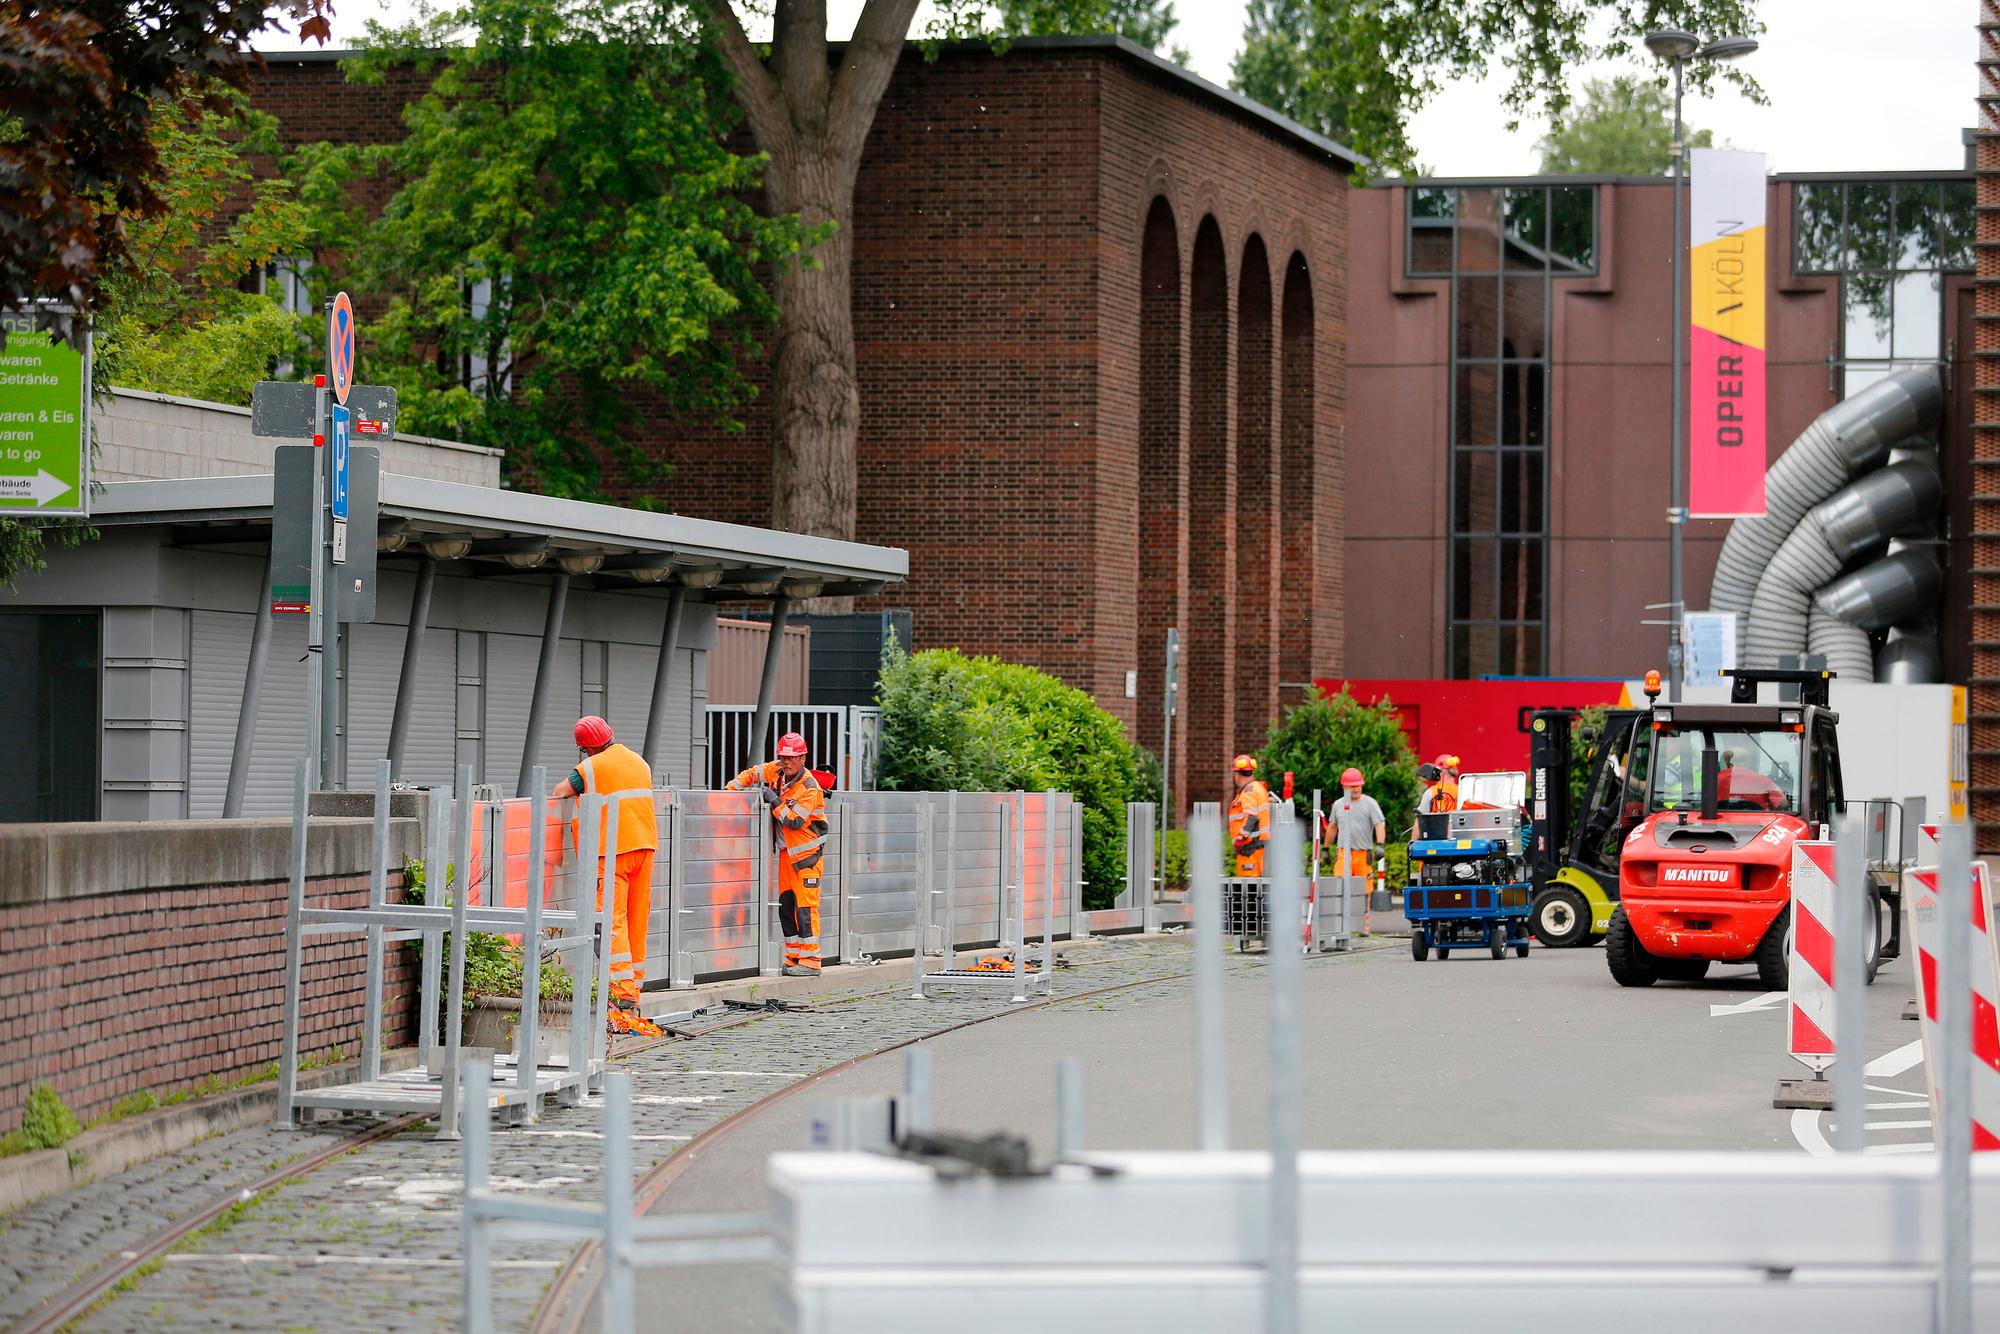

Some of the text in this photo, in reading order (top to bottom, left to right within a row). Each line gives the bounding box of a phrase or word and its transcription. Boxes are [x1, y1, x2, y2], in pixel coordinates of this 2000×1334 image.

[1711, 220, 1744, 295] KÖLN
[6, 334, 46, 347] inigung
[1716, 355, 1744, 448] OPER
[38, 409, 48, 423] &
[53, 410, 74, 423] Eis
[7, 448, 41, 463] to go
[0, 479, 31, 488] bäude
[1535, 768, 1546, 800] CLARK
[1664, 869, 1729, 882] MANITOU
